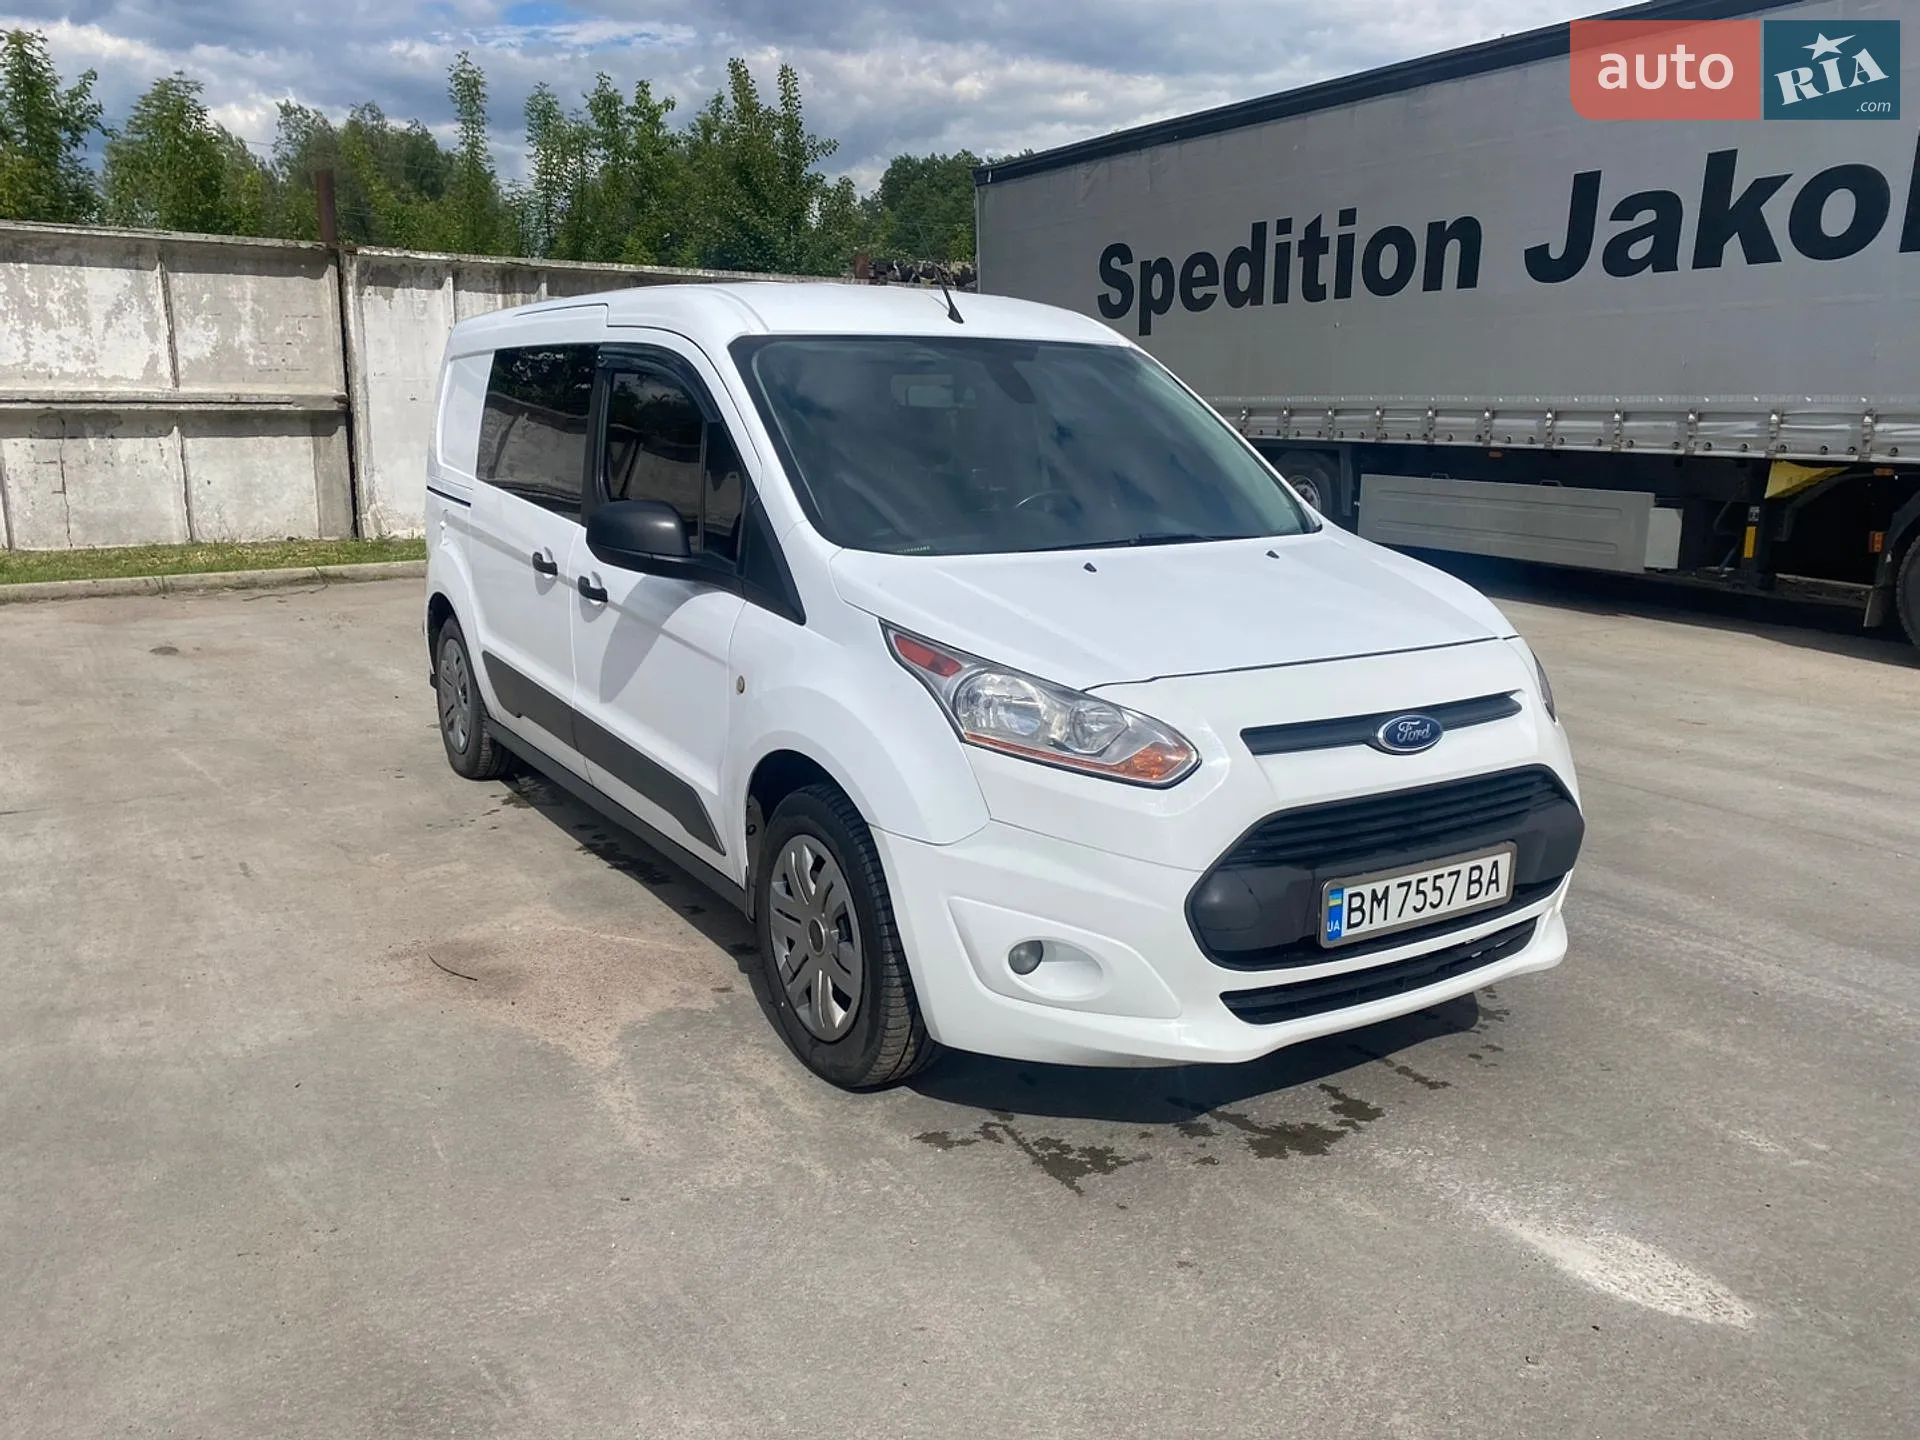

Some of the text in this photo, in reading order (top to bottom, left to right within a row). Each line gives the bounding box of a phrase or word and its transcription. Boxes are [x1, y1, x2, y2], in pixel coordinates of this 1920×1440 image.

[1097, 209, 1482, 336] Spedition
[1397, 721, 1431, 743] Ford
[1346, 859, 1500, 930] BM 7557 BA
[1326, 921, 1341, 933] UA
